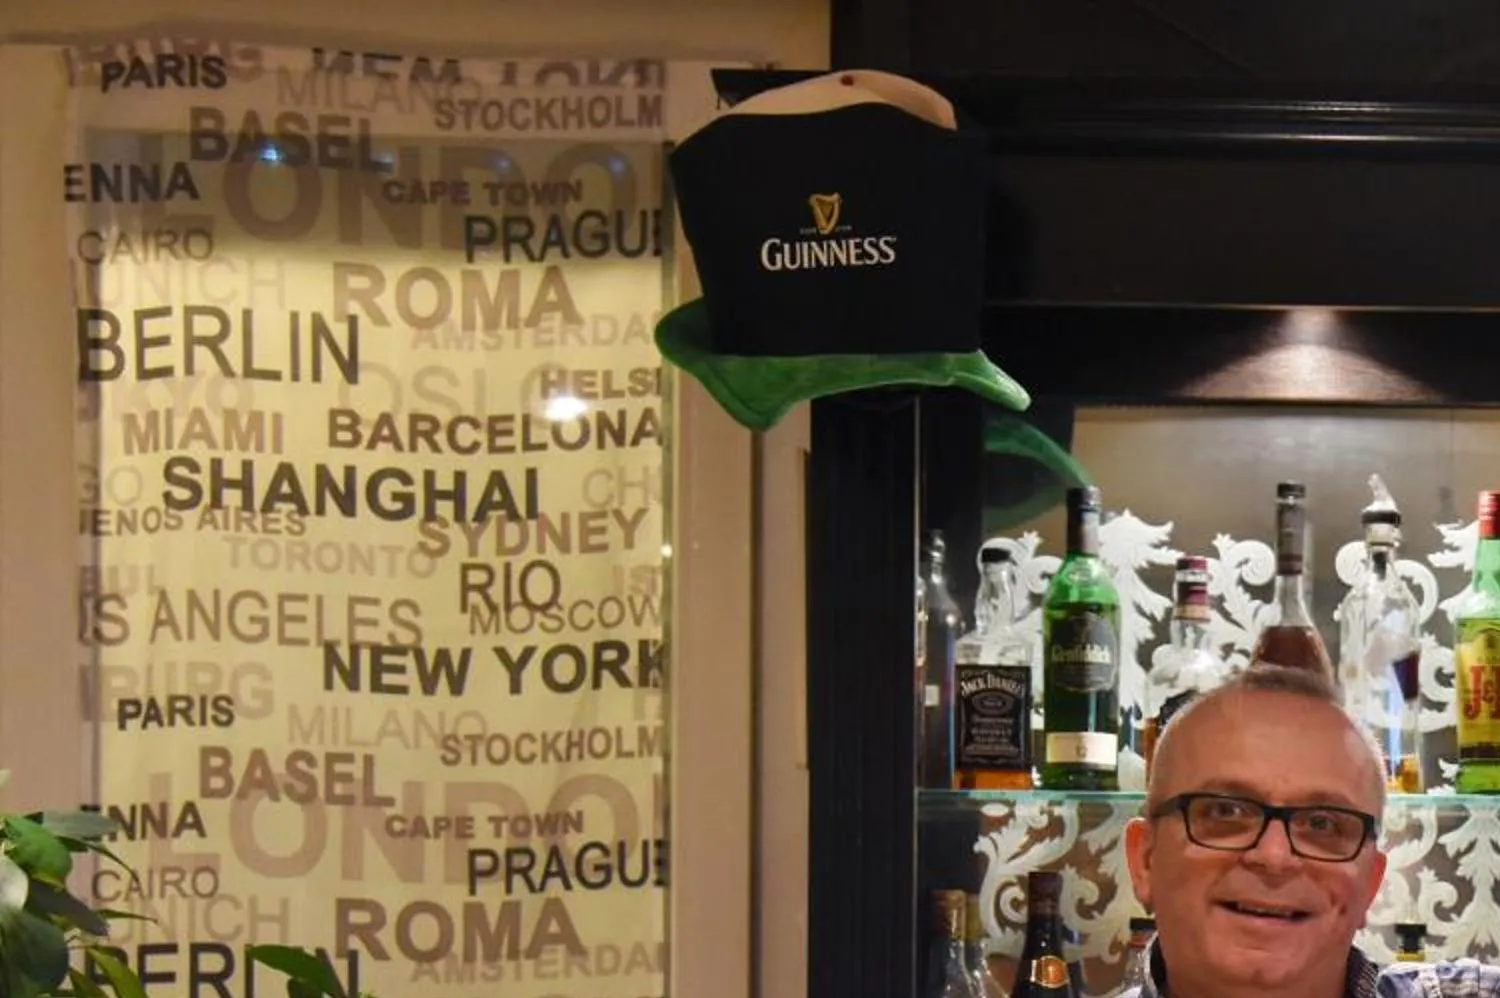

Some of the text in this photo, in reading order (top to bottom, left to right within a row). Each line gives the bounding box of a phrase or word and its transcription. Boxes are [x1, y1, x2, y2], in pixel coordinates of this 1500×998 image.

[101, 54, 227, 93] PARIS
[434, 95, 662, 132] STOCKHOLM
[190, 106, 392, 174] BASEL
[138, 133, 662, 252] LONDO
[382, 178, 582, 206] CAPE TOWN
[77, 226, 213, 265] CAIRO
[761, 236, 897, 271] GUINNESS
[70, 255, 286, 308] UNICH
[333, 262, 584, 331] ROMA
[77, 305, 359, 385] BERLIN
[411, 309, 662, 351] AMSTERDA
[122, 406, 283, 455] MIAMI
[328, 407, 662, 454] BARCELONA
[162, 456, 539, 524] SHANGHAI
[197, 503, 306, 536] AIRES
[417, 508, 648, 558] SYDNEY
[222, 536, 438, 578] TORONTO
[460, 560, 561, 614] RIO
[150, 588, 423, 648] ANGELES
[470, 594, 662, 635] MOSCOW
[323, 639, 665, 696] NEW YORK
[80, 661, 274, 722] BURG
[117, 695, 235, 731] PARIS
[287, 703, 487, 749] MILANO
[440, 724, 662, 767] STOCKHOLM
[198, 745, 395, 806] BASEL
[80, 800, 207, 842] NNA
[150, 773, 665, 885] LONDO
[385, 810, 583, 839] CAPE TOWN
[92, 866, 219, 903] CAIRO
[335, 897, 585, 963] ROMA
